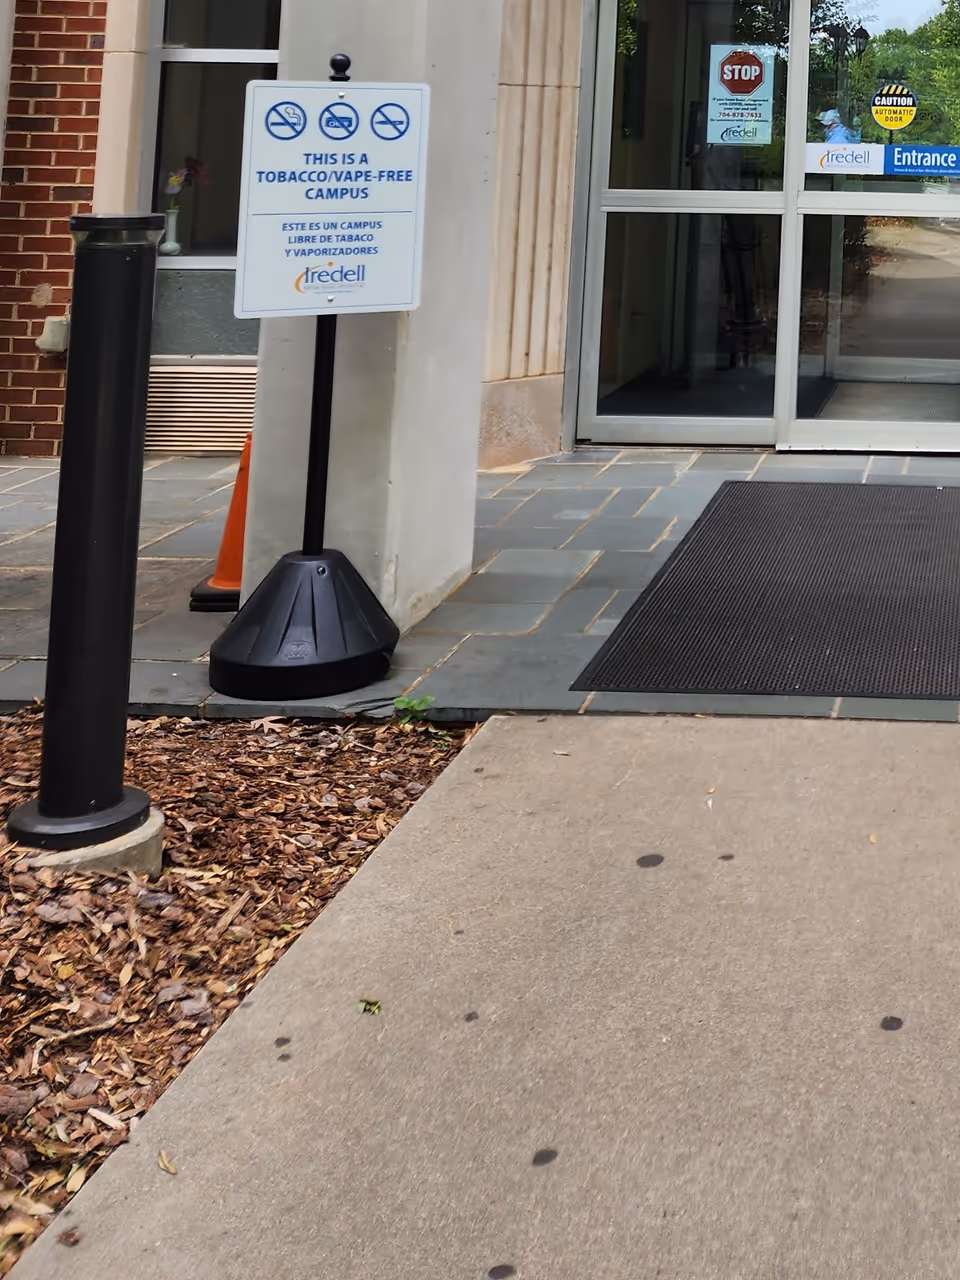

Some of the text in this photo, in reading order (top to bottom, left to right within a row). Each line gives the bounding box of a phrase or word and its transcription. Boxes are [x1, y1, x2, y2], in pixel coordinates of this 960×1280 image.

[723, 65, 760, 80] STOP
[874, 96, 914, 106] CAUTION
[725, 127, 758, 138] Iredell
[303, 152, 369, 166] THIS IS A
[826, 150, 870, 164] Iredell
[893, 147, 957, 167] Entrance
[256, 169, 413, 183] TOBACCO/VAPE-FREE
[305, 187, 369, 200] CAMPUS
[282, 220, 382, 232] ESTE ES UN CAMPUS
[288, 233, 374, 244] LIBRE DE TABACO
[285, 246, 379, 258] Y VAPORIZADORES
[304, 264, 366, 284] Iredell
